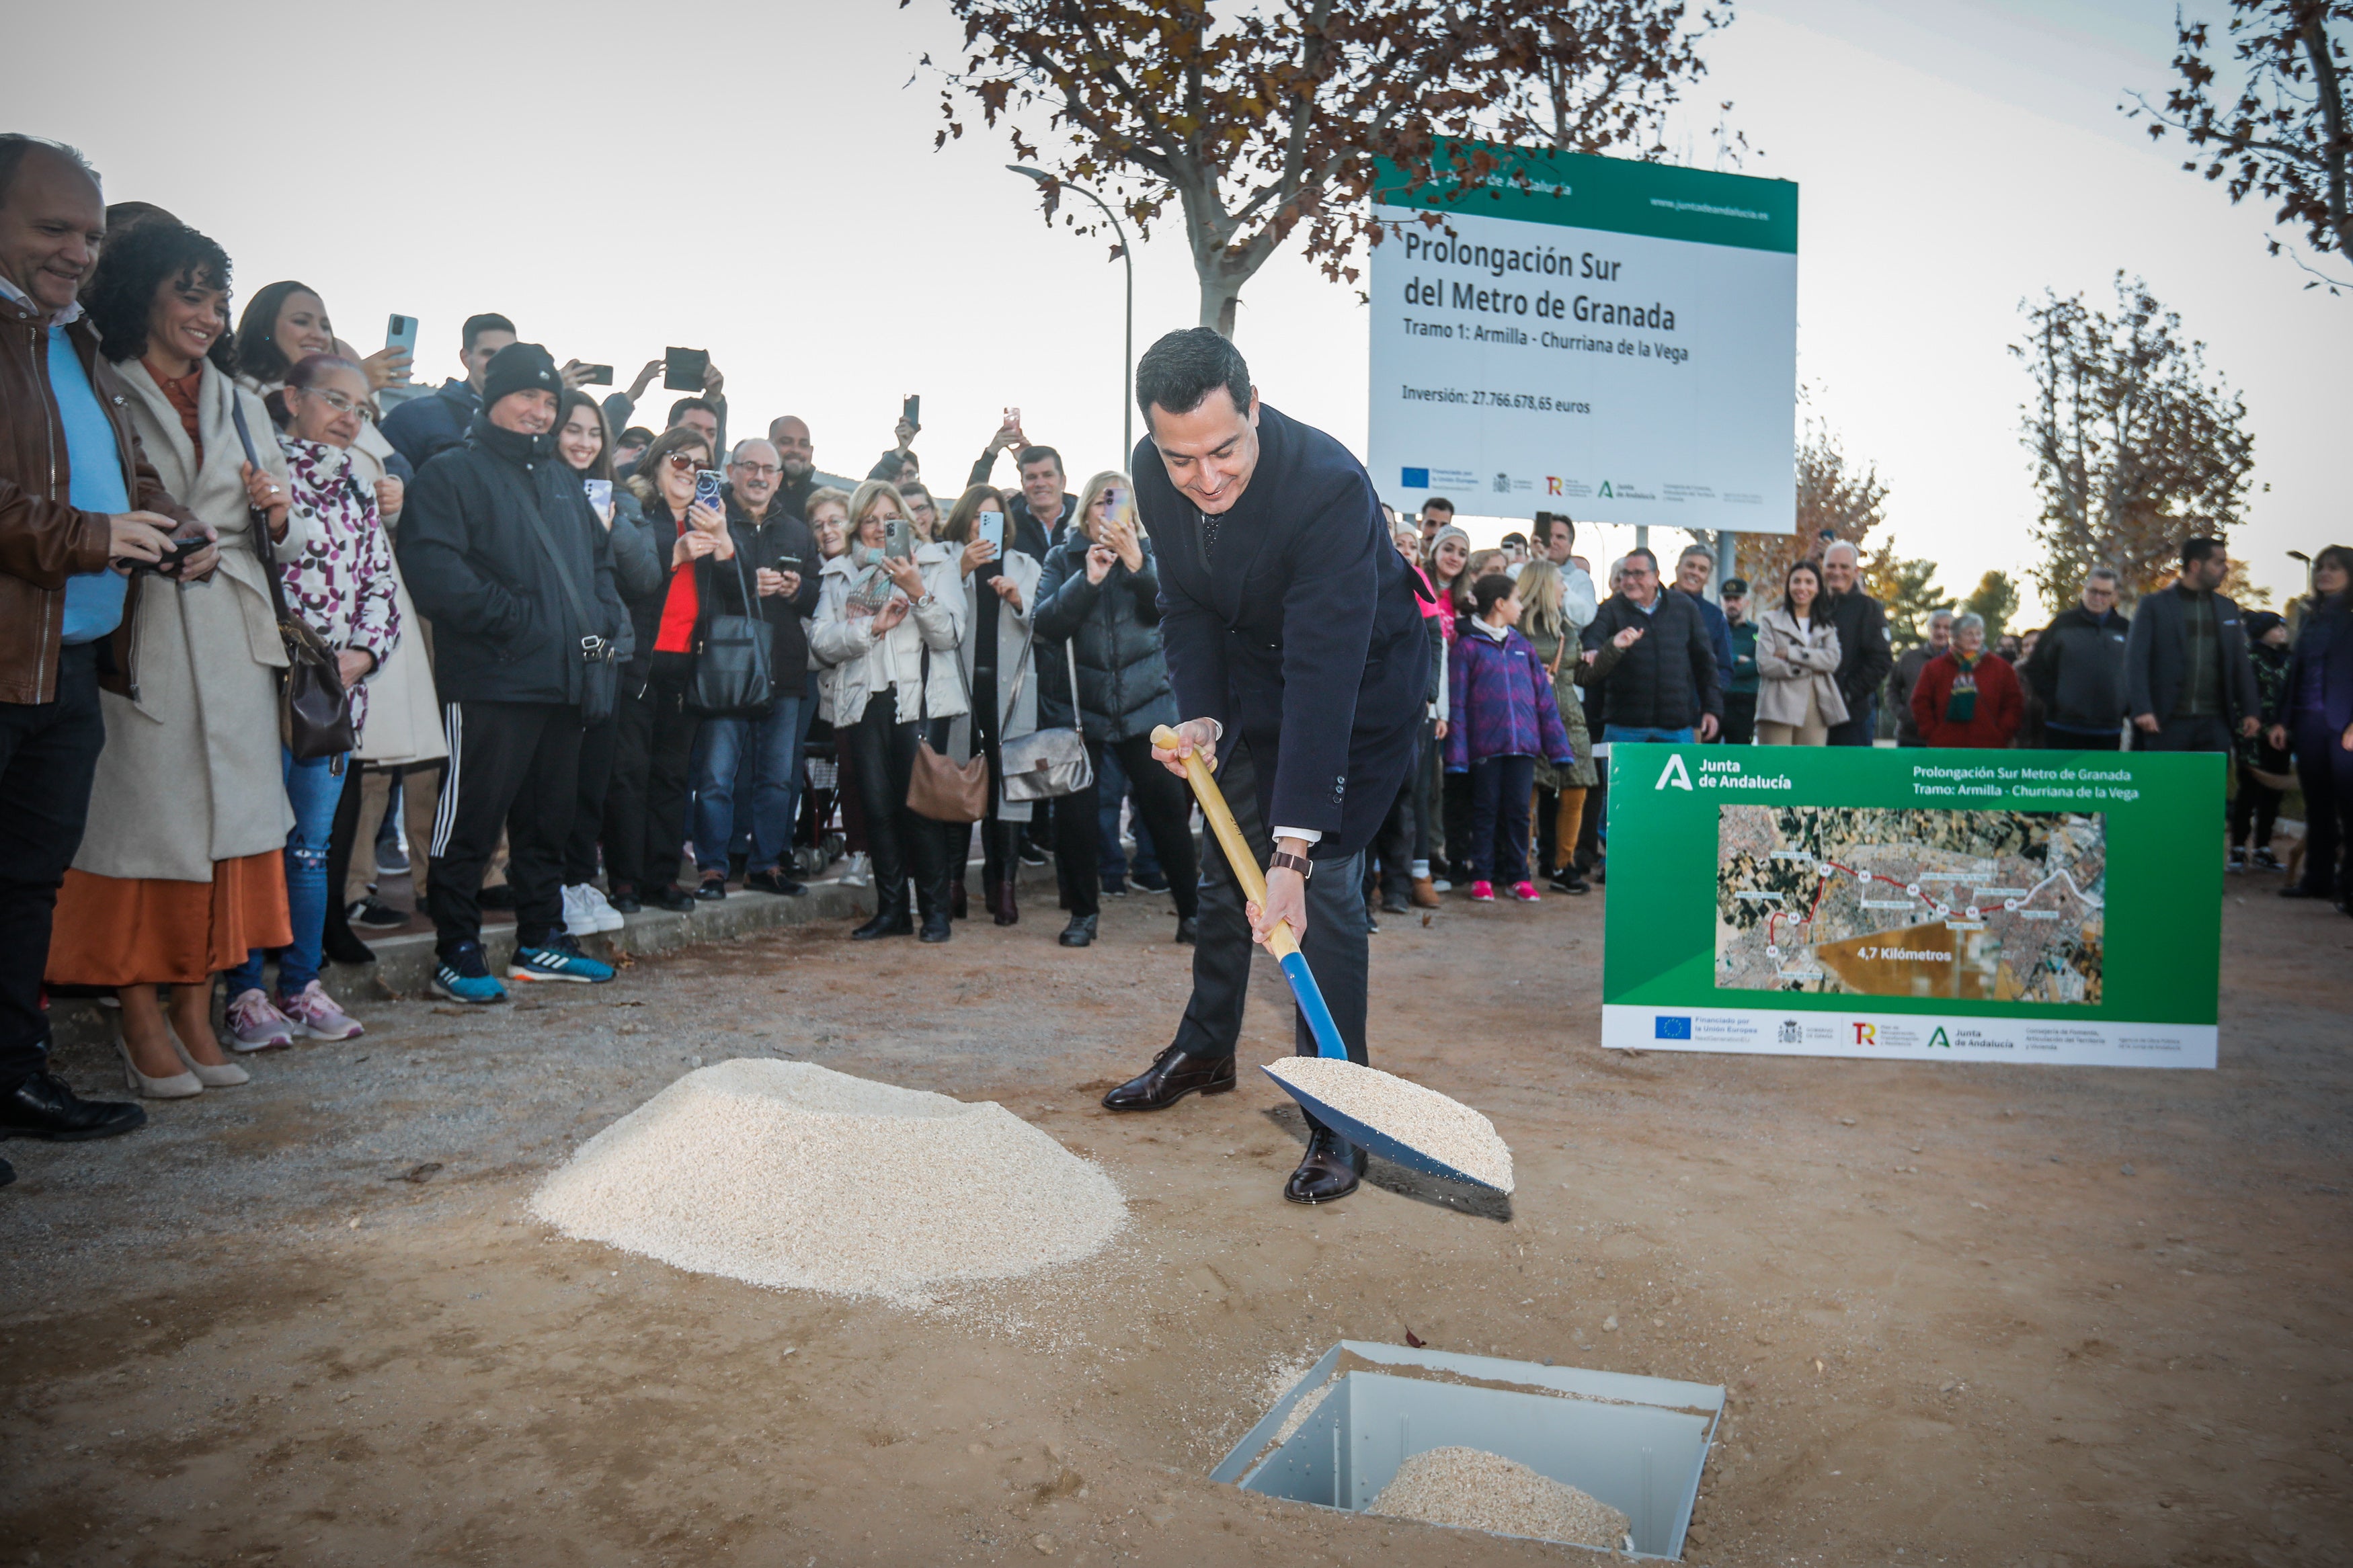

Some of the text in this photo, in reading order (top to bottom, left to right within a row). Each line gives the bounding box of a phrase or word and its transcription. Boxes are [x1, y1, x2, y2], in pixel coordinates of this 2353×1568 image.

[1406, 232, 1622, 282] Prolongación Sur
[1404, 276, 1675, 330] del Metro de Granada
[1403, 318, 1452, 338] Tramo
[1457, 323, 1470, 341] 1:
[1474, 325, 1528, 345] Armilla
[1541, 331, 1613, 354] Churriana
[1618, 338, 1634, 356] de
[1638, 340, 1650, 358] la
[1654, 343, 1689, 365] Vega
[1402, 384, 1591, 414] Inversión: 27.766.678,65 euros
[1699, 758, 1741, 772] Junta
[1913, 766, 2131, 781] Prolongación Sur Metro de Granada
[1698, 774, 1792, 790] de Andalucía
[1913, 782, 1956, 796] Tramo:
[1958, 784, 2003, 797] Armilla
[2012, 784, 2074, 798] Churriana
[2076, 785, 2093, 798] de
[2095, 786, 2106, 798] la
[2108, 787, 2139, 801] Vega
[1858, 947, 1951, 962] 4,7 Kilómetros
[1696, 1016, 1735, 1024] Financiado
[1727, 1026, 1757, 1035] Europea
[1956, 1029, 1981, 1037] Junta
[1955, 1038, 2013, 1048] de Andalucía
